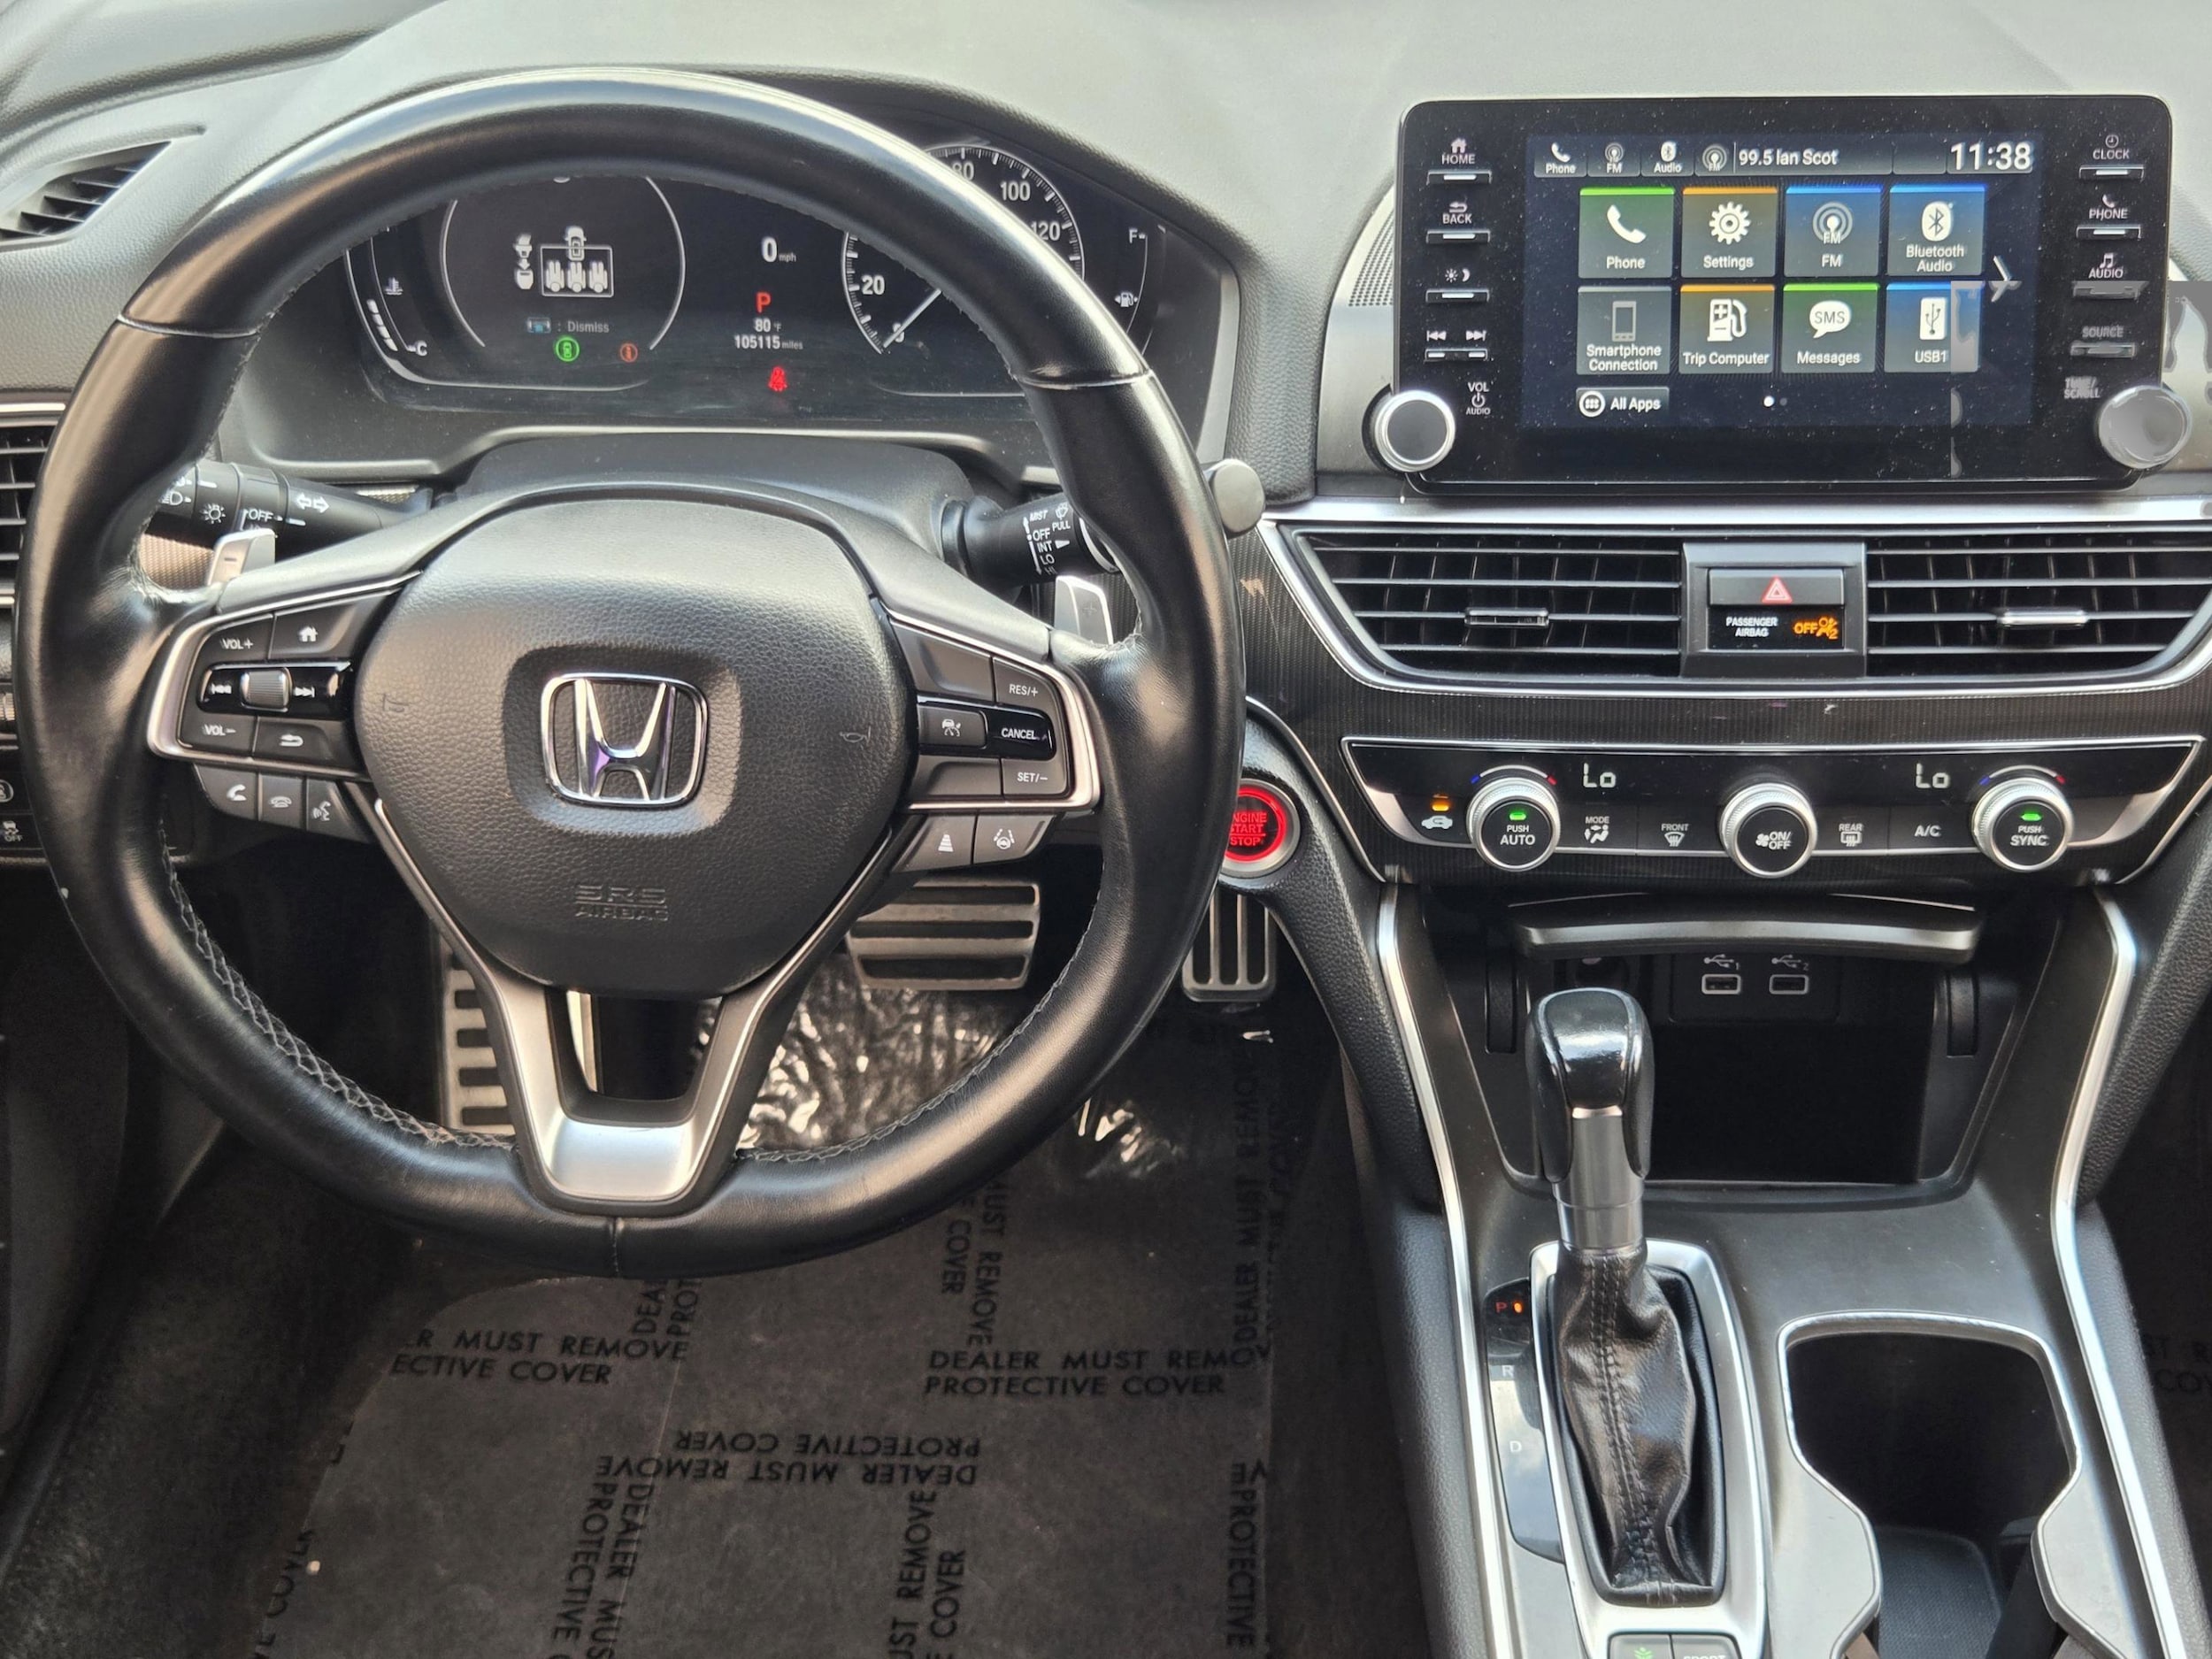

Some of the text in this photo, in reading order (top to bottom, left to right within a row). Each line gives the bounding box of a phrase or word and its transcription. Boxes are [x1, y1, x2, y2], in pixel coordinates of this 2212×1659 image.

[1442, 154, 1475, 165] HOME
[1739, 148, 1839, 165] 99.5 Ian Scot
[1951, 142, 2032, 171] 11:38
[2093, 150, 2130, 159] CLOCK
[1546, 163, 1576, 173] Phone
[1607, 164, 1622, 173] FM
[1654, 163, 1682, 173] Audio
[1000, 181, 1031, 201] 100
[1442, 214, 1472, 224] BACK
[2089, 209, 2128, 219] PHONE
[762, 236, 796, 263] 0 mph
[1906, 244, 1964, 257] Bluetooth
[1606, 257, 1646, 269] Phone
[1703, 256, 1754, 271] Settings
[1822, 255, 1841, 267] FM
[1916, 259, 1952, 273] Audio
[2089, 269, 2124, 279] AUDIO
[862, 275, 885, 296] 20
[757, 292, 771, 313] P
[1814, 311, 1845, 324] SMS
[567, 321, 610, 334] Dismiss
[755, 319, 771, 332] 80
[2082, 326, 2124, 338] SOURCE
[733, 335, 803, 349] 105115 miles
[1586, 344, 1662, 358] Smartphone
[1915, 350, 1947, 363] USB1
[1589, 358, 1657, 371] Connection
[1683, 352, 1769, 366] Trip Computer
[1797, 351, 1860, 365] Messages
[1468, 382, 1489, 392] VOL
[1610, 397, 1661, 411] All Apps
[249, 509, 273, 522] OFF
[1030, 511, 1048, 522] MIST
[1052, 521, 1071, 532] PULL
[1033, 528, 1050, 541] OFF
[1037, 541, 1052, 553] INT
[1040, 554, 1055, 565] LO
[1726, 617, 1778, 627] PASSENGER
[1793, 622, 1816, 634] OFF
[1735, 627, 1769, 637] AIRBAG
[221, 639, 253, 649] VOL+
[1009, 684, 1038, 697] RES/+
[1001, 727, 1038, 741] CANCEL
[1017, 772, 1048, 783] SET/-
[1585, 816, 1609, 825] MODE
[1770, 832, 1791, 841] ON/
[1915, 825, 1941, 837] A/C
[1231, 836, 1261, 846] STOP
[1500, 834, 1535, 845] AUTO
[1769, 841, 1791, 849] OFF
[2010, 835, 2048, 847] SYNC
[941, 1219, 972, 1295] COVER
[967, 1250, 1003, 1347] REMOVE
[1495, 1302, 1507, 1313] P
[453, 1330, 542, 1351] MUST
[559, 1334, 691, 1363] REMOVE
[927, 1349, 1041, 1371] DEALER
[1064, 1349, 1148, 1371] MUST
[510, 1361, 613, 1385] COVER
[1502, 1364, 1514, 1377] R
[923, 1375, 1225, 1398] PROTECTIVE COVER
[673, 1429, 979, 1457] PROTECTIVE COVER
[1509, 1441, 1522, 1453] D
[595, 1455, 978, 1486] DEALER MUST REMOVE
[605, 1483, 655, 1581] DEALER
[895, 1489, 938, 1601] REMOVE
[550, 1482, 618, 1642] PROTECTIVE
[1226, 1489, 1257, 1647] PROTECTIVE
[929, 1550, 967, 1640] COVER
